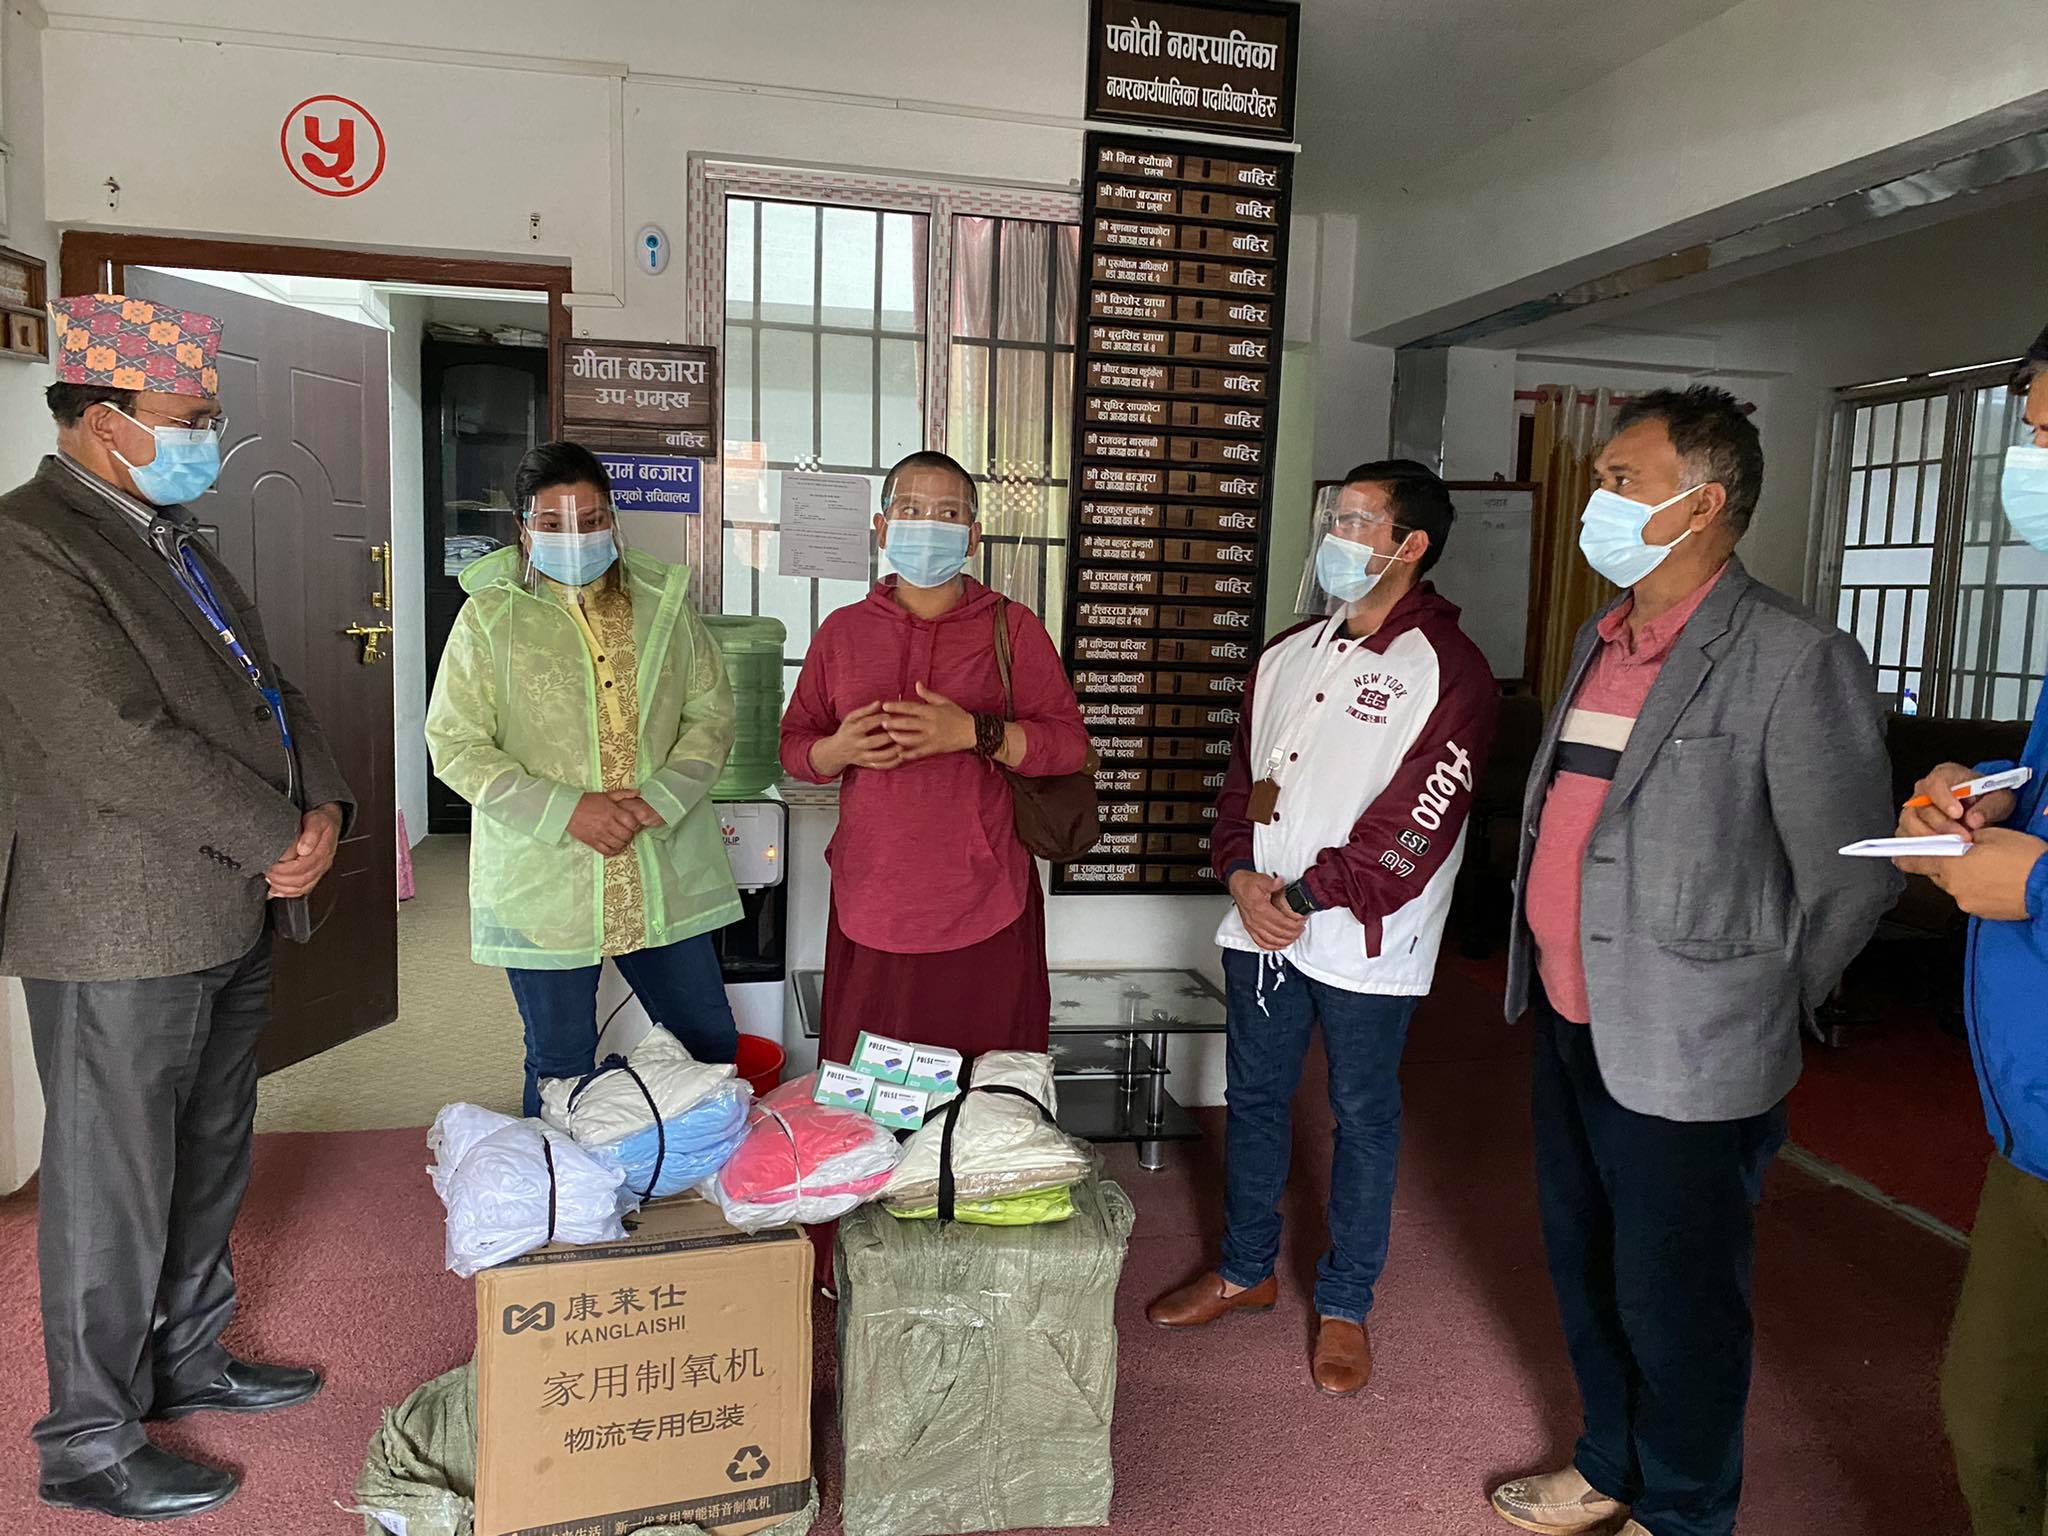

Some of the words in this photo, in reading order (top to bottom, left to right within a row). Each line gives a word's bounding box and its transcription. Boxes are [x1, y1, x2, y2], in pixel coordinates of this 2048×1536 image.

[1106, 17, 1162, 57] पनौती
[1168, 30, 1278, 71] नगरपालिका
[1107, 76, 1199, 107] नगरकार्यपालिका
[1101, 150, 1113, 162] श्री
[1238, 168, 1275, 186] बाहिर
[1100, 185, 1111, 197] श्री
[1115, 186, 1135, 199] गीता
[1235, 200, 1273, 218] बाहिर
[1099, 220, 1107, 230] श्री
[1232, 234, 1269, 252] बाहिर
[1229, 269, 1267, 286] बाहिर
[1095, 292, 1107, 303] श्री
[1110, 293, 1140, 305] किशोर
[1144, 297, 1165, 307] थापा
[1229, 304, 1267, 322] बाहिर
[1094, 328, 1105, 338] श्री
[1143, 332, 1164, 341] थापा
[1229, 340, 1266, 358] बाहिर
[572, 349, 622, 379] गीता
[1224, 375, 1262, 392] बाहिर
[1091, 399, 1100, 409] श्री
[1126, 402, 1160, 412] सापकोटा
[1224, 411, 1262, 427] बाहिर
[666, 431, 705, 447] बाहिर
[1088, 433, 1098, 444] श्री
[1223, 444, 1261, 461] बाहिर
[639, 464, 693, 482] बन्जारा
[1087, 469, 1098, 480] श्री
[1220, 479, 1257, 494] बाहिर
[645, 488, 691, 503] सचिवालय
[1084, 503, 1094, 513] श्री
[1219, 513, 1255, 529] बाहिर
[1217, 546, 1253, 561] बाहिर
[1083, 570, 1093, 581] श्री
[1215, 578, 1252, 594] बाहिर
[1080, 603, 1090, 614] श्री
[1213, 611, 1250, 626] बाहिर
[1078, 639, 1088, 649] श्री
[1211, 643, 1249, 658] बाहिर
[1076, 673, 1086, 683] श्री
[1110, 673, 1144, 683] अधिकारी
[1209, 677, 1246, 692] बाहिर
[1354, 673, 1382, 688] NEW
[1384, 675, 1408, 698] YORK
[1207, 709, 1240, 724] बाहिर
[1206, 740, 1232, 755] बाहि
[722, 836, 740, 845] ULIP
[1400, 832, 1427, 854] EST.
[869, 1042, 886, 1051] PULSE
[917, 1056, 934, 1064] PULSE
[827, 1071, 845, 1080] PULSE
[880, 1090, 898, 1099] PULSE
[562, 1284, 687, 1321] 康莱仕
[566, 1315, 686, 1346] KANGLAISHI
[541, 1347, 764, 1409] 家用制氧机
[564, 1404, 745, 1454] 物流专用包装
